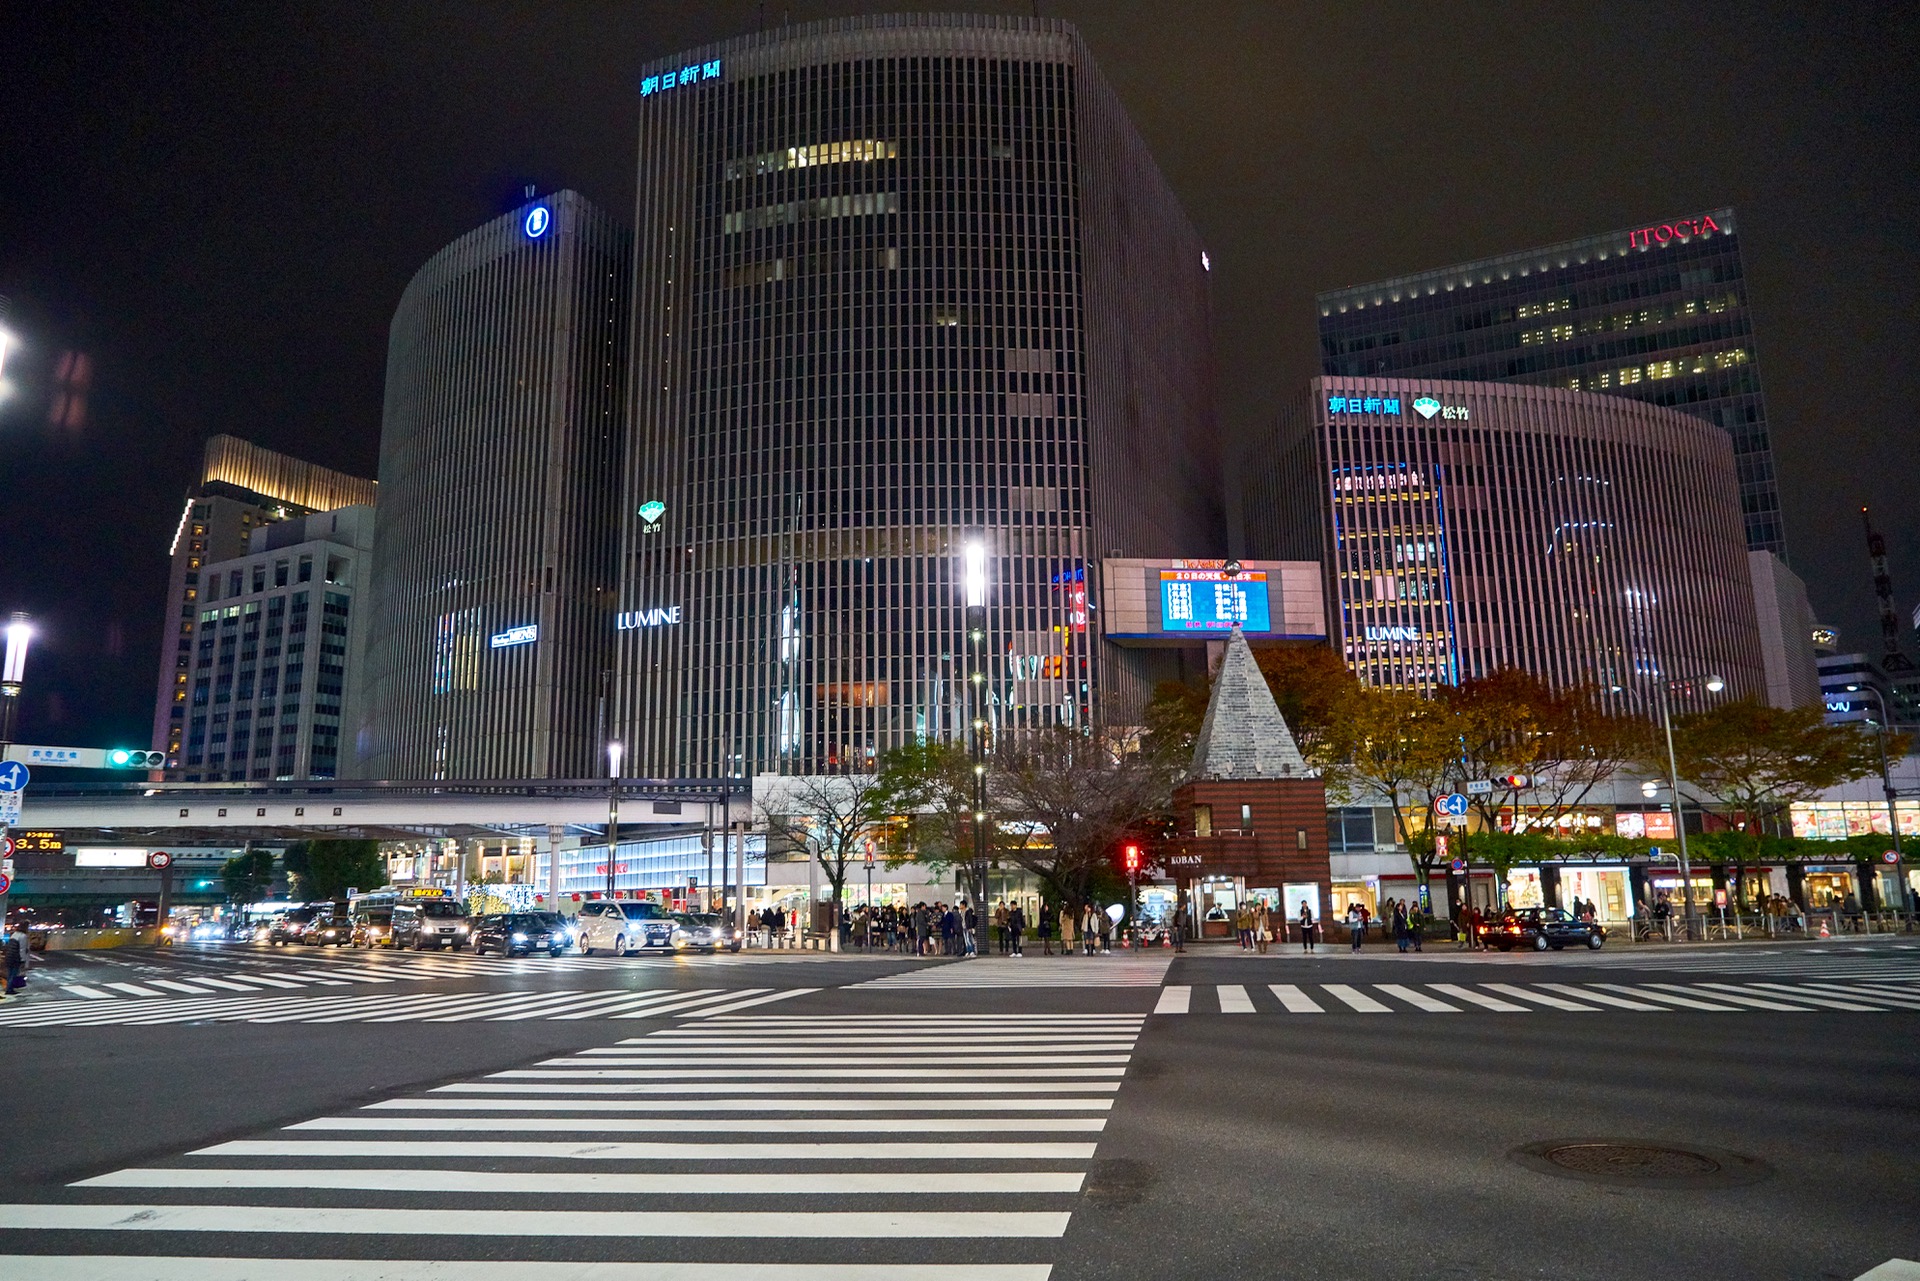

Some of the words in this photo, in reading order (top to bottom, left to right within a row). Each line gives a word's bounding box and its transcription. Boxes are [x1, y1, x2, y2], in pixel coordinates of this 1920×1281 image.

[640, 59, 721, 97] 朝日新聞
[1629, 215, 1719, 248] ITOCiA
[1328, 396, 1400, 415] 朝日新聞
[1442, 406, 1469, 420] 松竹
[643, 523, 661, 534] 松竹
[1176, 572, 1251, 581] 20日の天気・日本
[618, 606, 680, 630] LUMINE
[1366, 626, 1419, 641] LUMINE
[15, 838, 62, 849] 3.5m
[1171, 855, 1202, 864] KOBAN
